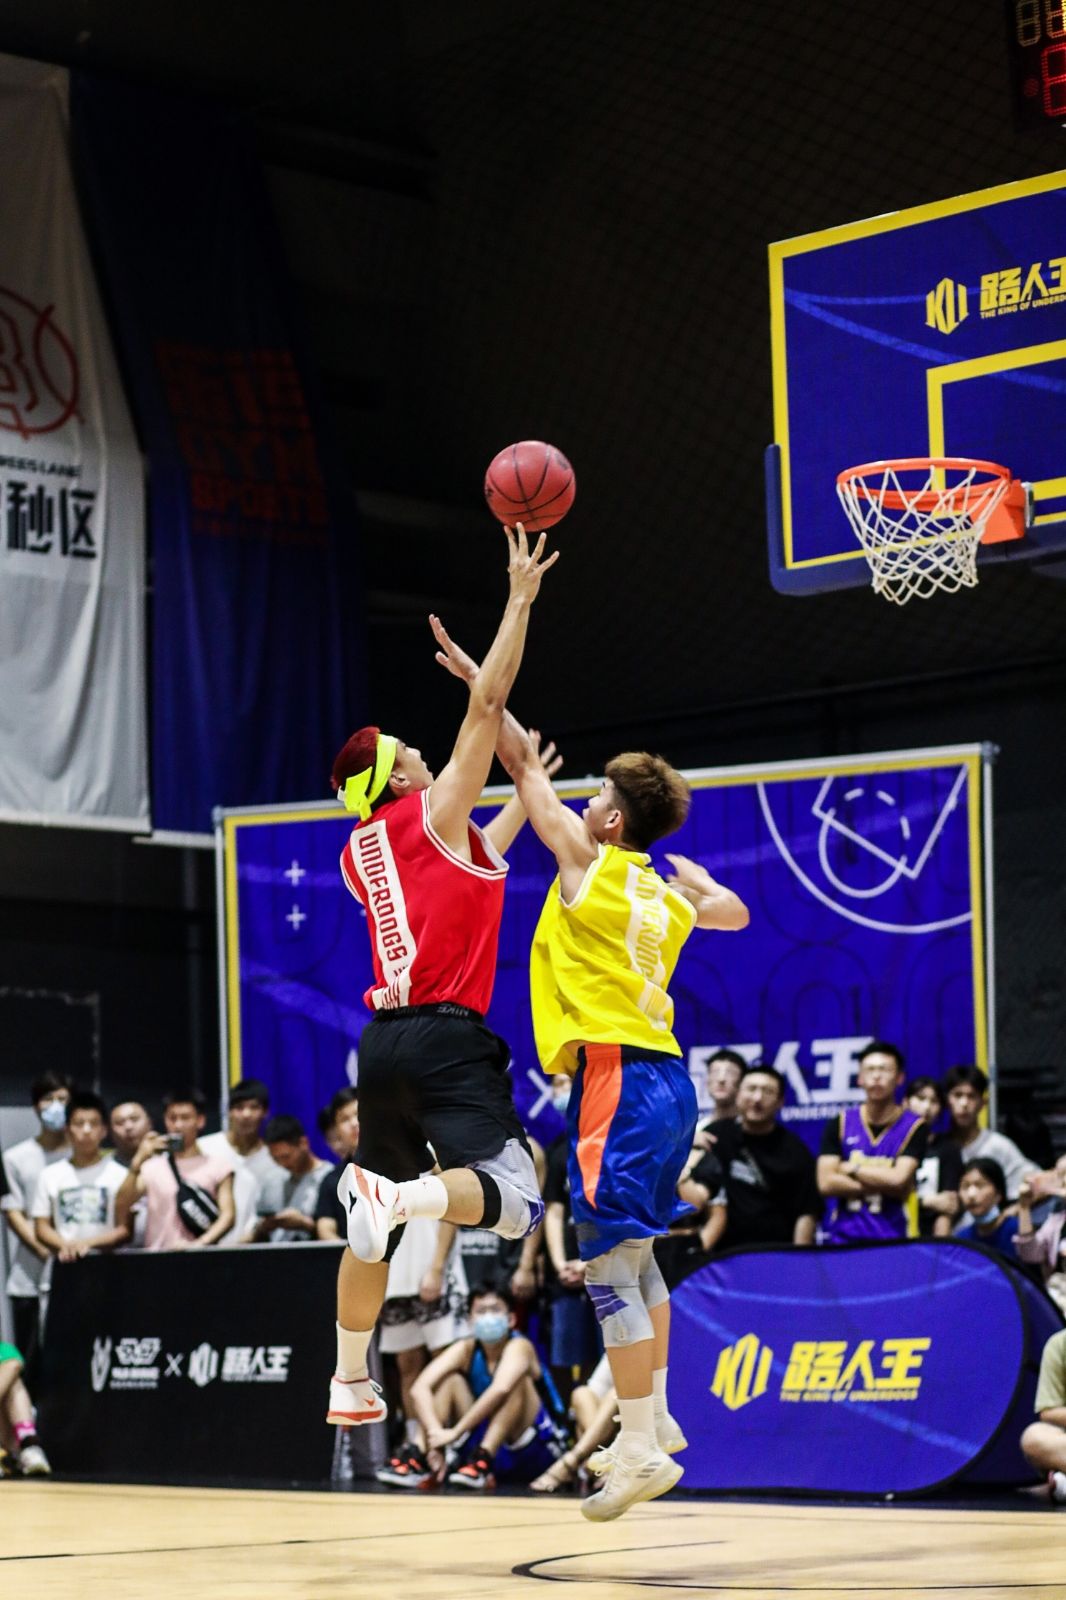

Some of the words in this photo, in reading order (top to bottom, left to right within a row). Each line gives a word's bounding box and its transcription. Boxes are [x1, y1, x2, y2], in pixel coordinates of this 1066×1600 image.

[980, 309, 996, 318] THE
[997, 304, 1018, 315] KING
[1020, 301, 1030, 310] OF
[781, 1337, 931, 1391] 路人王
